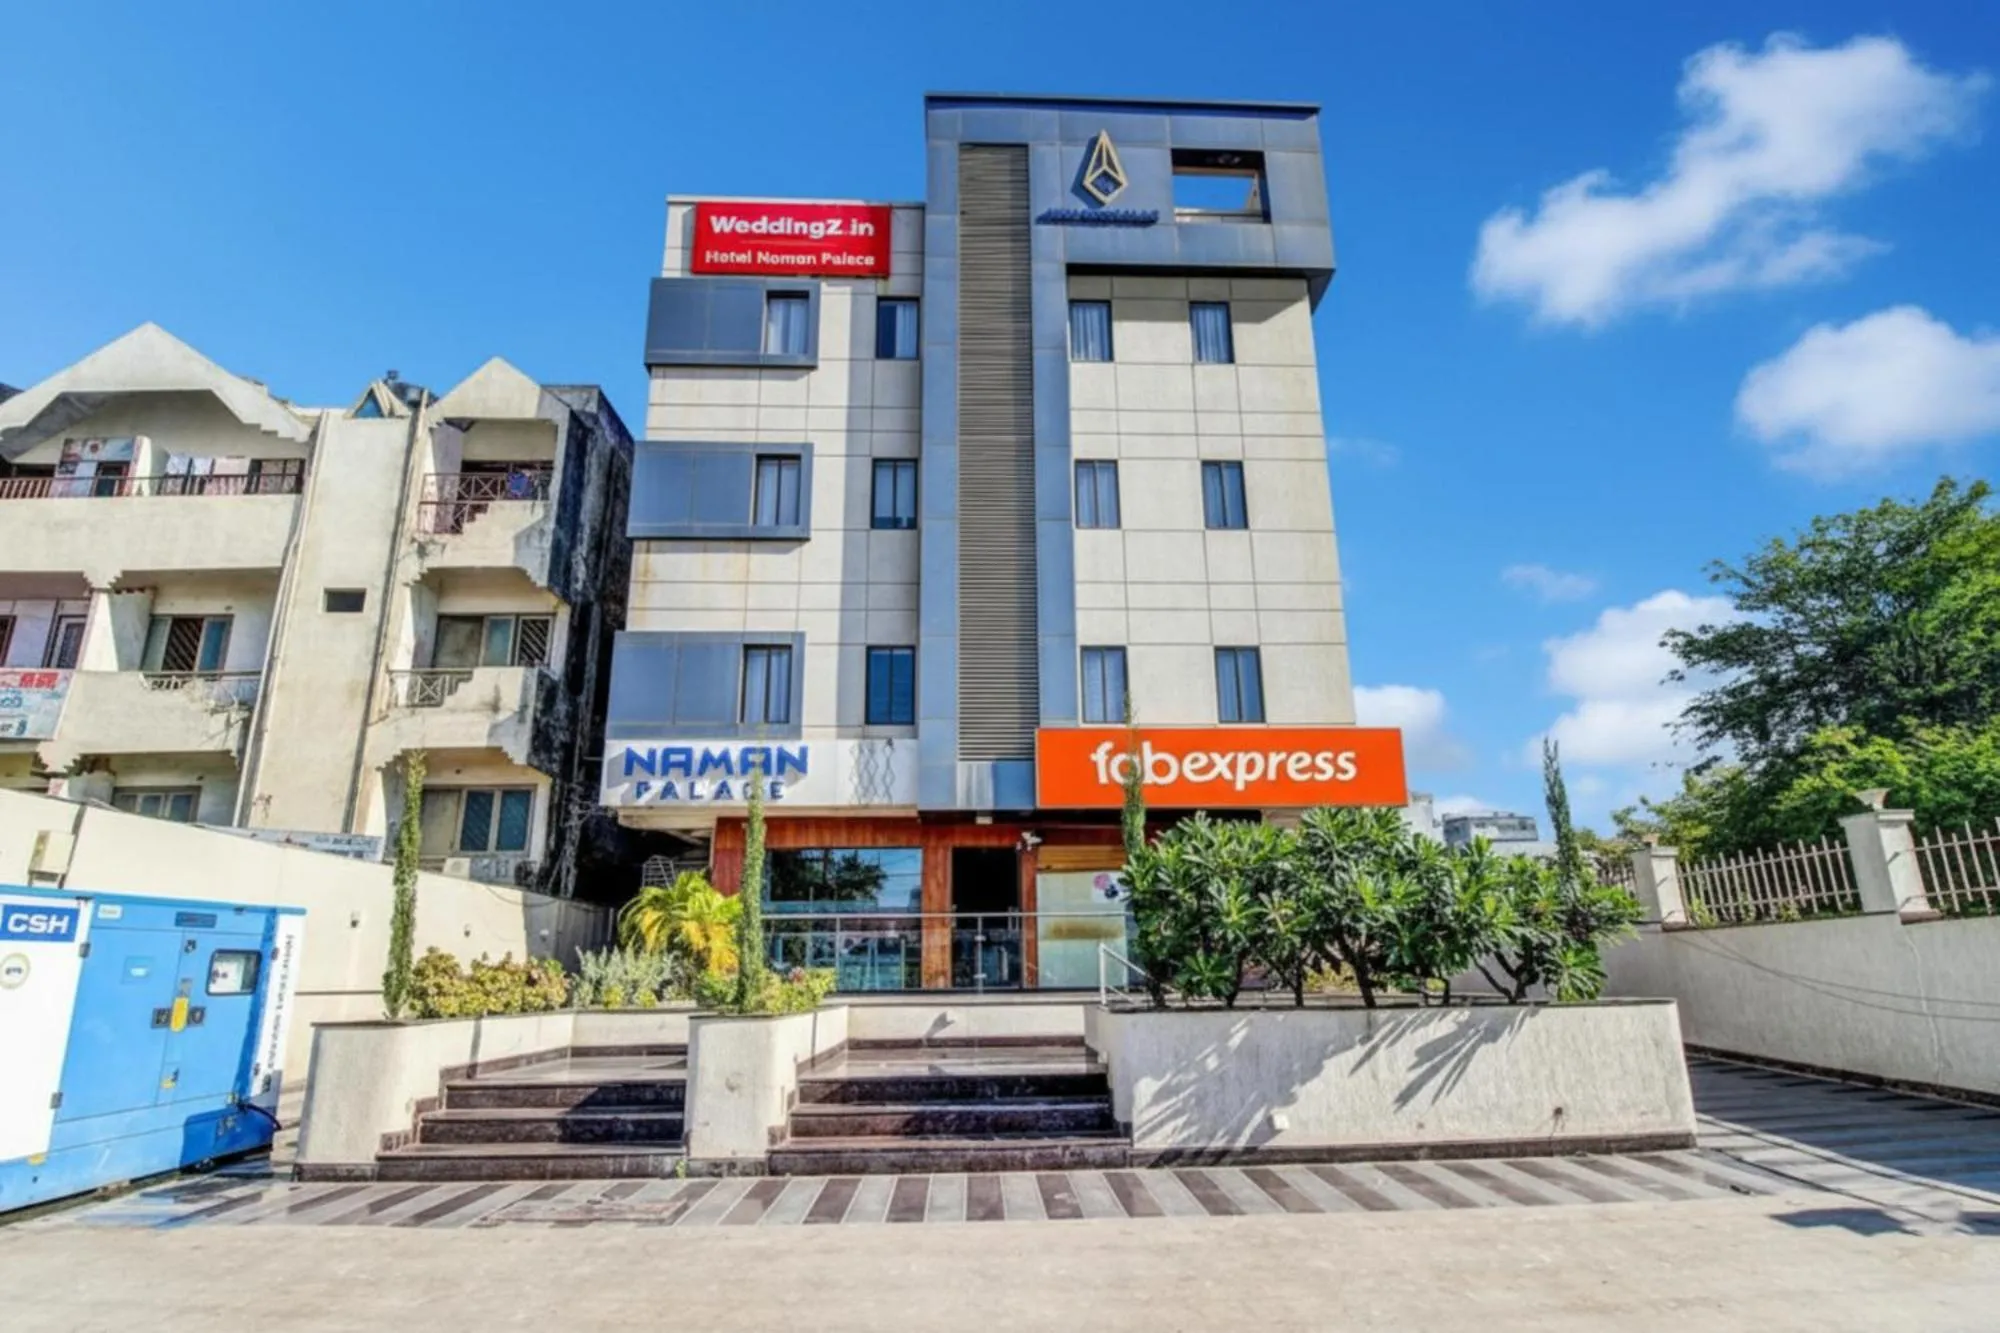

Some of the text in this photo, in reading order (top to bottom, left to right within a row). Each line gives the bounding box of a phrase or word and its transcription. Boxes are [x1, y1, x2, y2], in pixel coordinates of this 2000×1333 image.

[705, 250, 752, 264] Hotel
[624, 746, 809, 777] NAMAN
[1090, 741, 1358, 791] fabexpress
[7, 912, 70, 935] CSH
